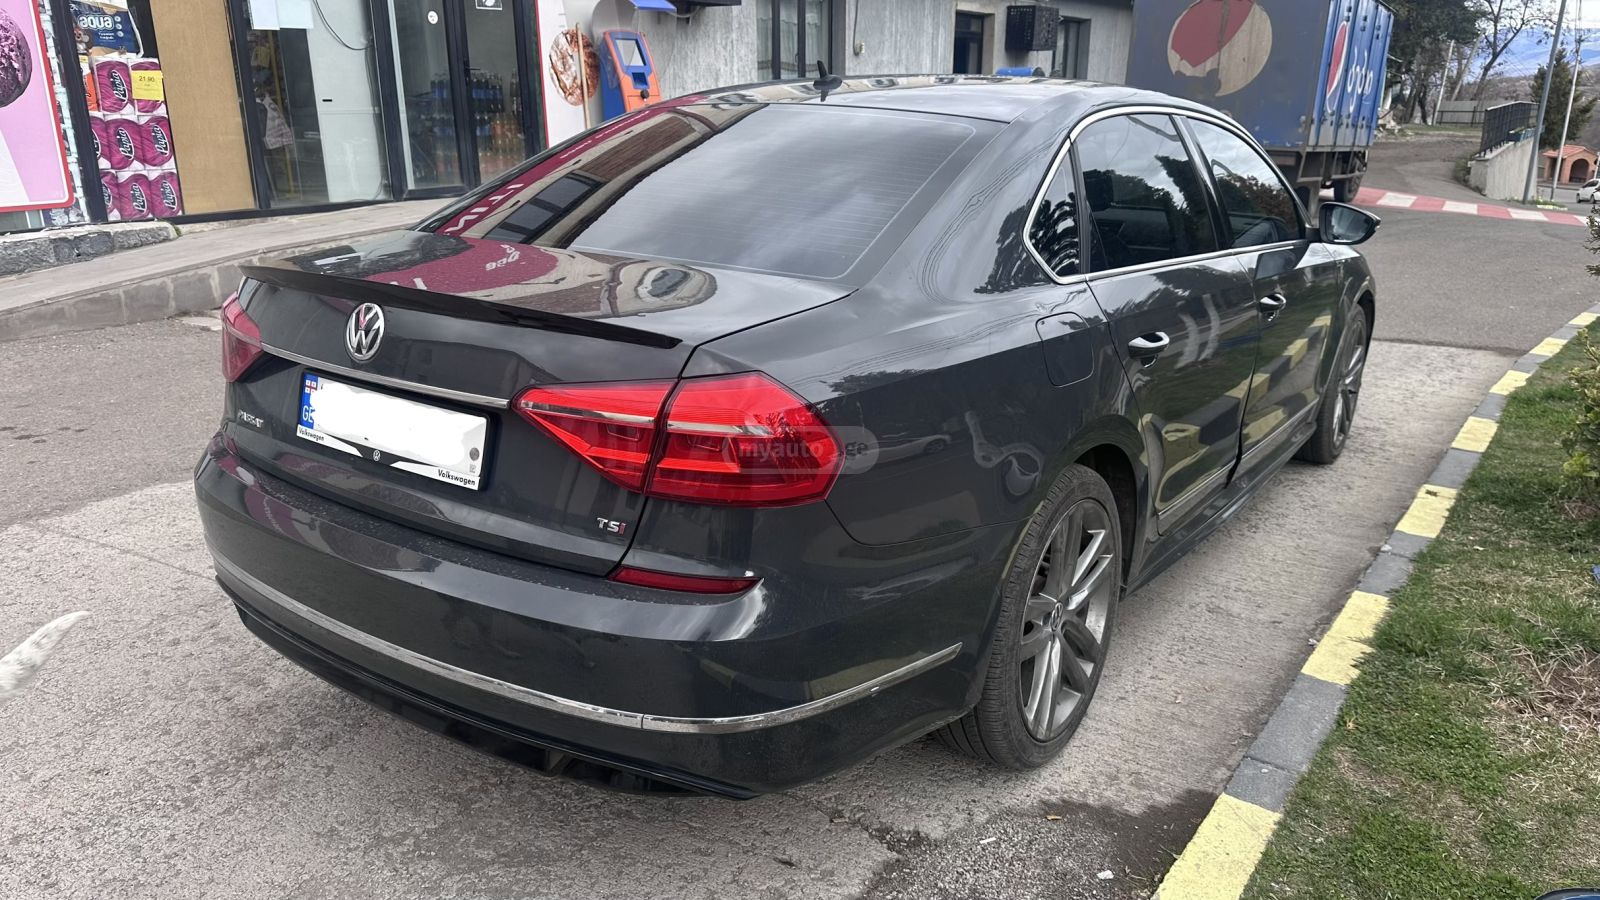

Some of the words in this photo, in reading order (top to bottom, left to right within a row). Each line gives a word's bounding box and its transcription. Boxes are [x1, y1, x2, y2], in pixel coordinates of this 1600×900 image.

[79, 15, 113, 29] aqua
[298, 426, 325, 442] Volkswagen
[437, 468, 476, 486] Volkswagen
